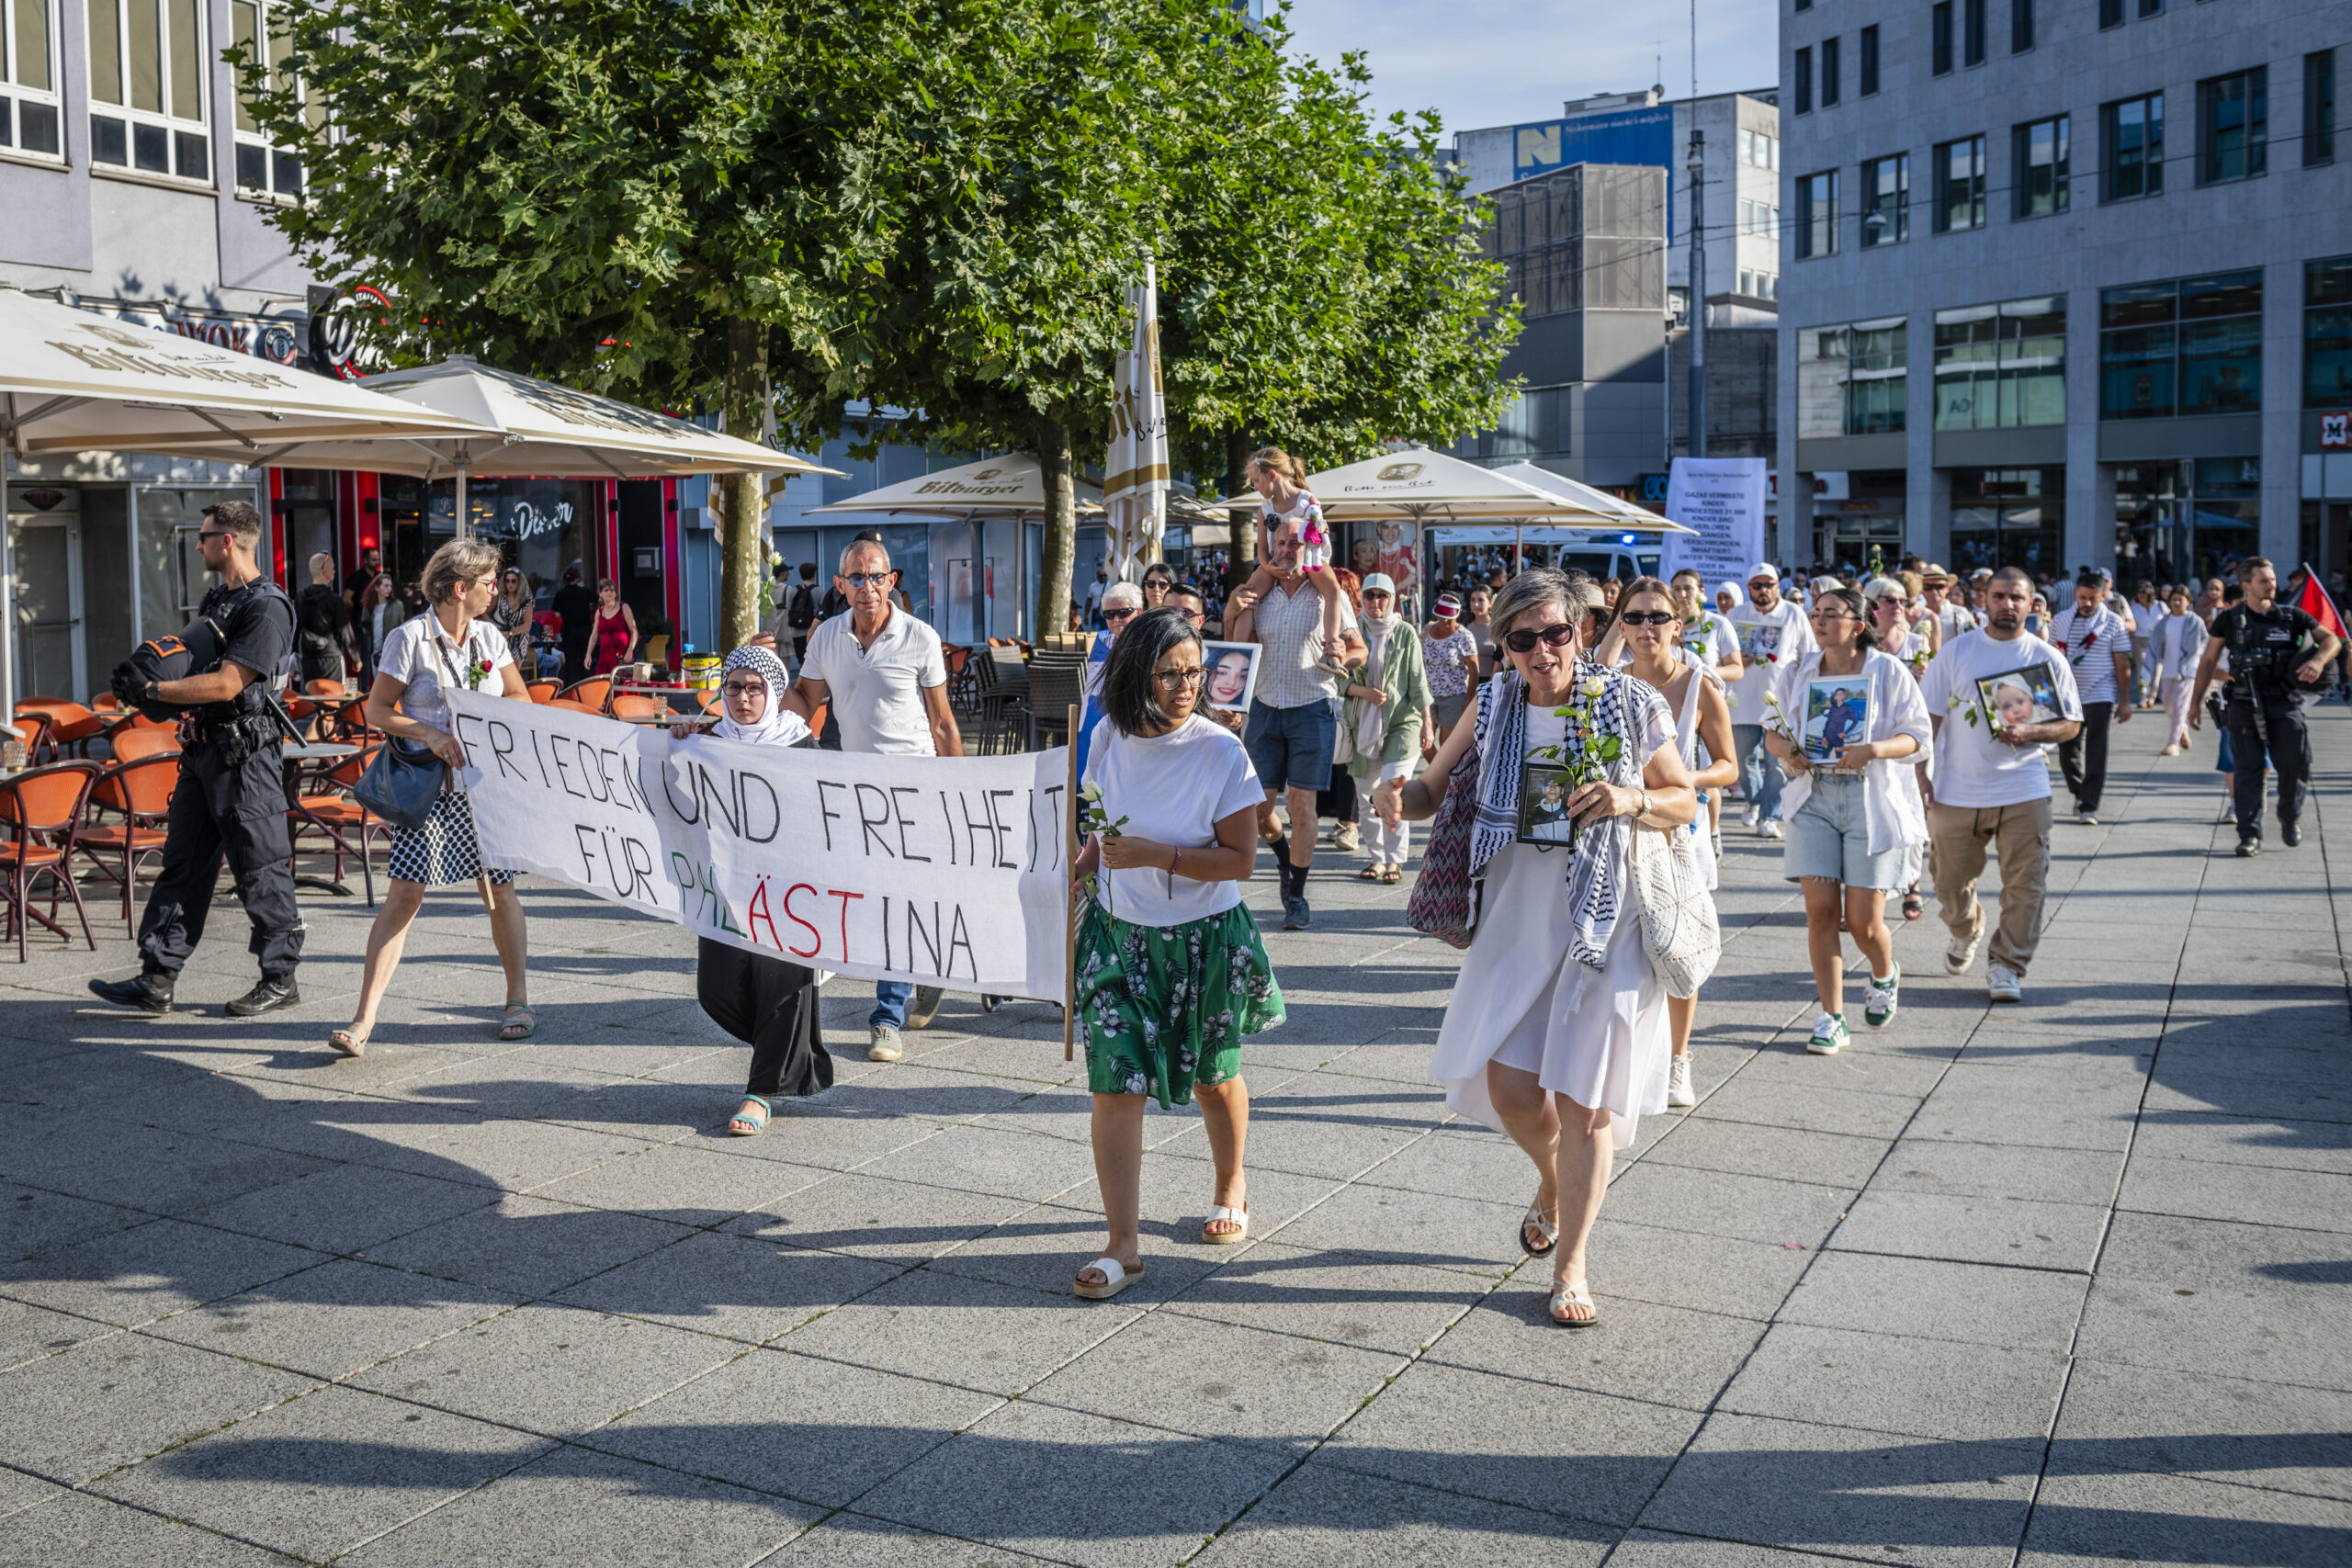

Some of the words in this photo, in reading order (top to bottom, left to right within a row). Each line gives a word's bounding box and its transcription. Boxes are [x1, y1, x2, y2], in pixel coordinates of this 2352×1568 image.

[44, 340, 298, 389] Bitburger
[911, 481, 1024, 496] Bitburger
[456, 713, 656, 817] FRIEDEN
[662, 759, 781, 845] UND
[817, 779, 1066, 874] FREIHEIT
[574, 824, 659, 906] FÜR
[671, 851, 978, 983] PALÄSTINA
